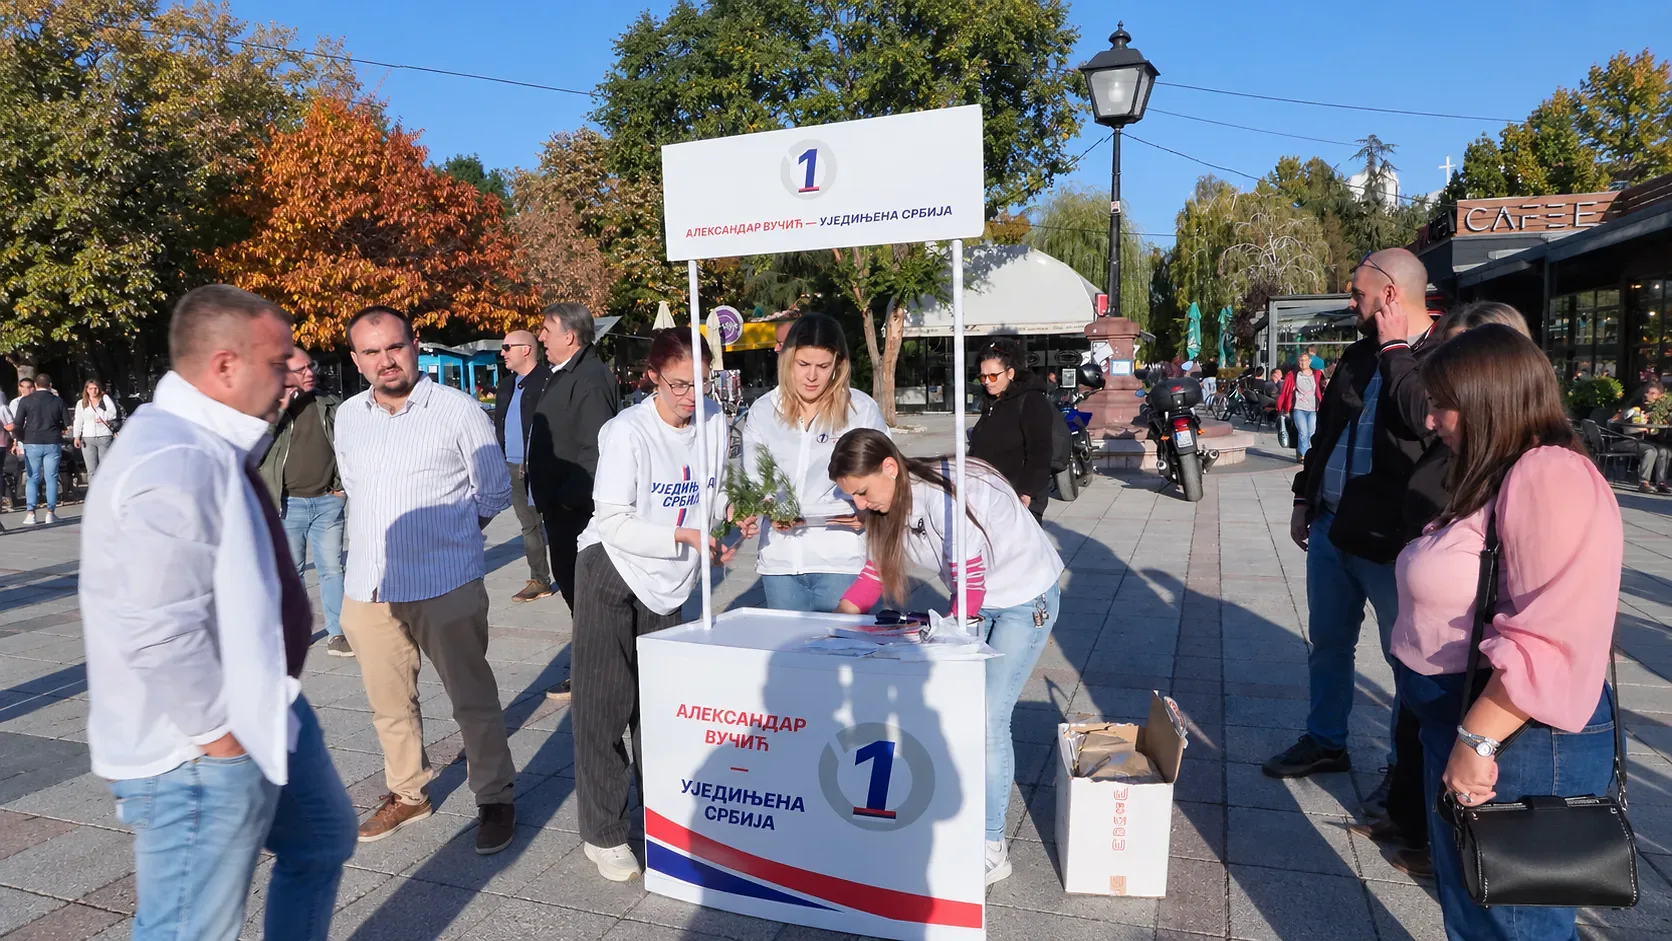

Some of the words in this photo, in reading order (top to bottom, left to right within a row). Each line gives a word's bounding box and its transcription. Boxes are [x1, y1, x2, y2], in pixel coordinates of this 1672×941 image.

[798, 148, 820, 193] 1
[685, 222, 761, 238] АЛЕКСАНДАР
[763, 219, 803, 232] ВУЧИЋ
[819, 211, 899, 227] УЈЕДИЊЕНА
[902, 205, 953, 220] СРБИЈА
[676, 703, 807, 733] АЛЕКСАНДАР
[704, 729, 769, 752] ВУЧИЋ
[681, 779, 806, 813] УЈЕДИЊЕНА
[852, 739, 897, 820] 1
[704, 805, 776, 831] СРБИЈА
